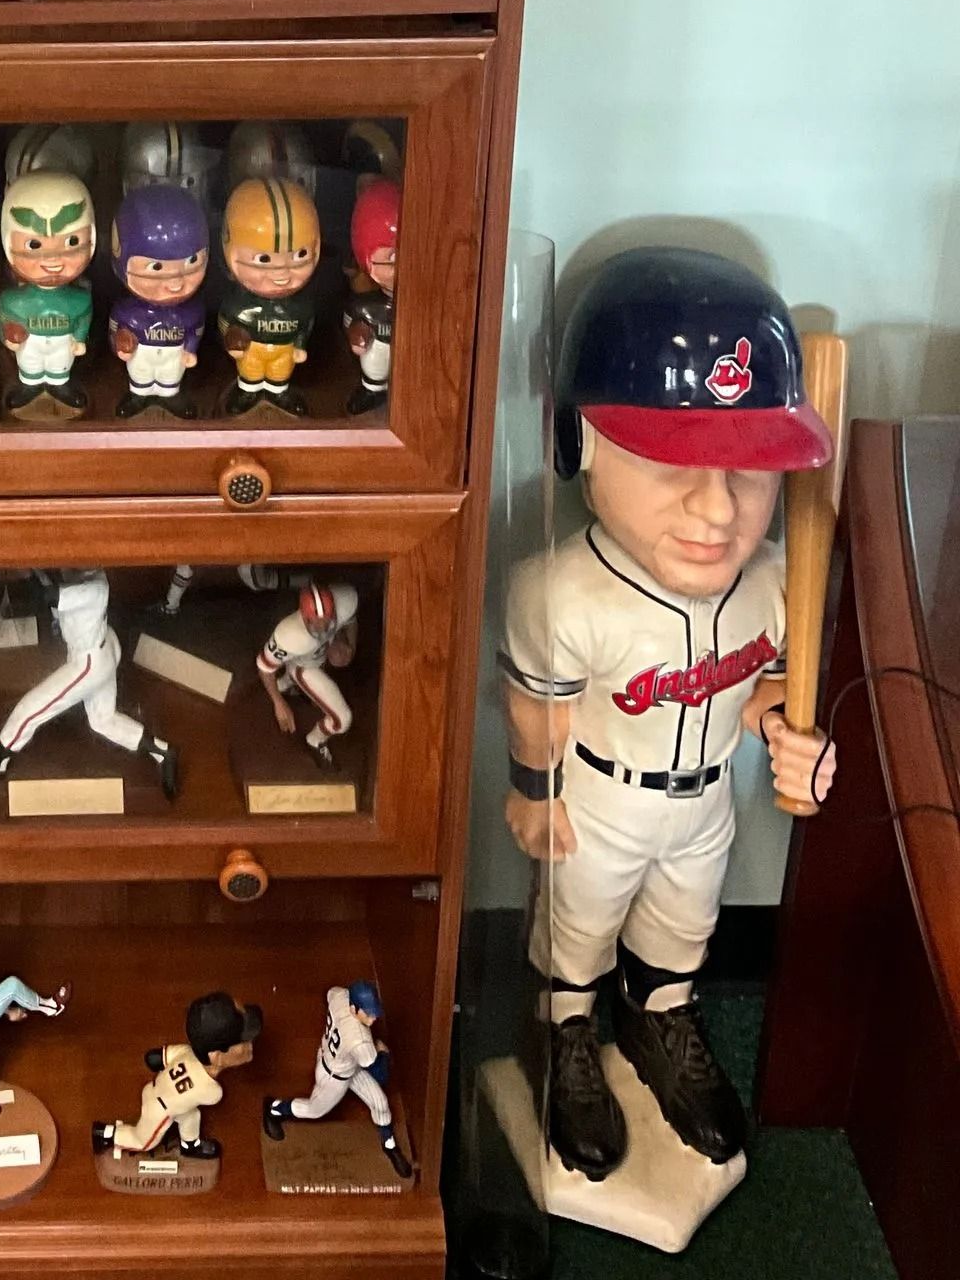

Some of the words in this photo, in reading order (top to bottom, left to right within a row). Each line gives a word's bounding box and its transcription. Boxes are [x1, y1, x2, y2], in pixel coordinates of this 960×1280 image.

[28, 316, 70, 330] EAGLES
[143, 322, 185, 341] VIKINGS
[256, 318, 298, 333] PACKERS
[611, 628, 779, 716] Indians
[168, 1062, 194, 1095] 36
[303, 1184, 337, 1194] PAPPAS
